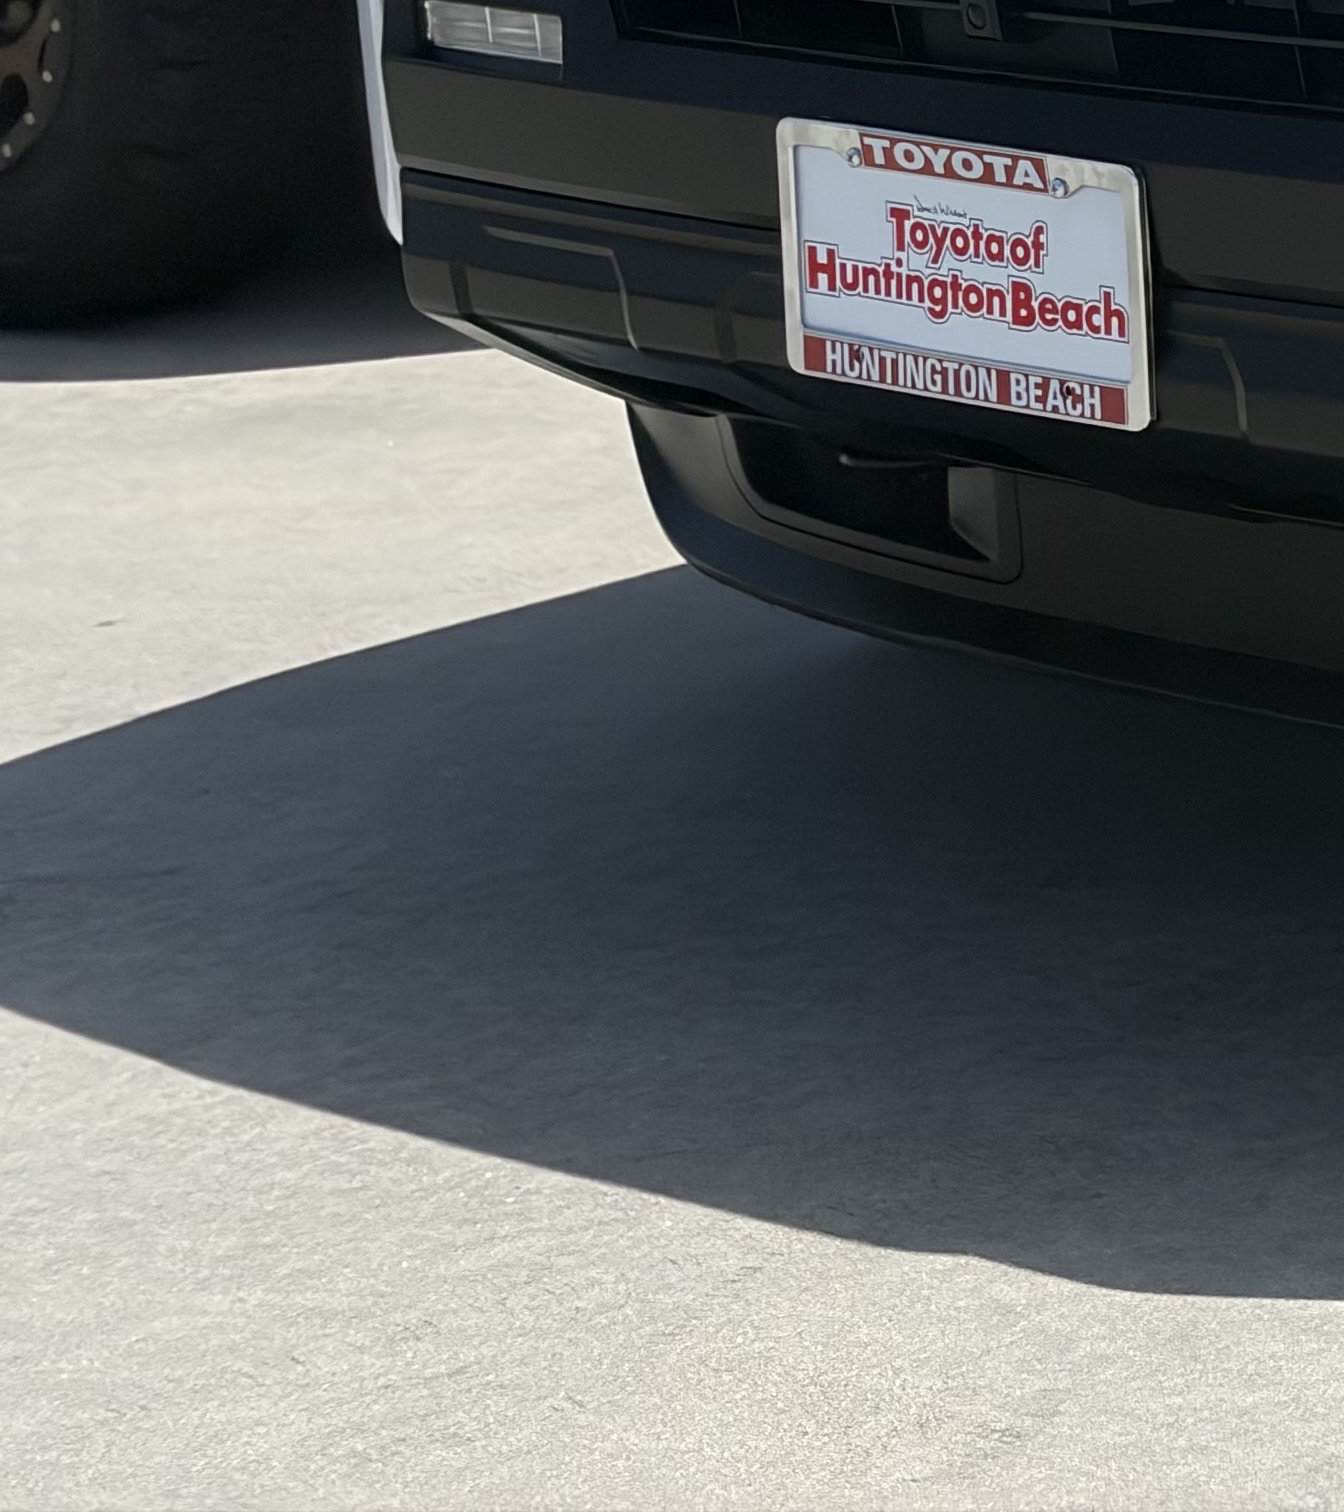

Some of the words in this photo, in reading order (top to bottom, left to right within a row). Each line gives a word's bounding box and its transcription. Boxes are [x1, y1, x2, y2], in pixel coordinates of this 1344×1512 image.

[862, 136, 1045, 189] TOYOTA
[887, 203, 1008, 267] Toyota
[1009, 222, 1046, 271] of
[806, 244, 1007, 321] Huntington
[1010, 279, 1128, 340] Beach
[825, 339, 997, 403] HUNTINGTON
[1009, 372, 1101, 420] BEACH
